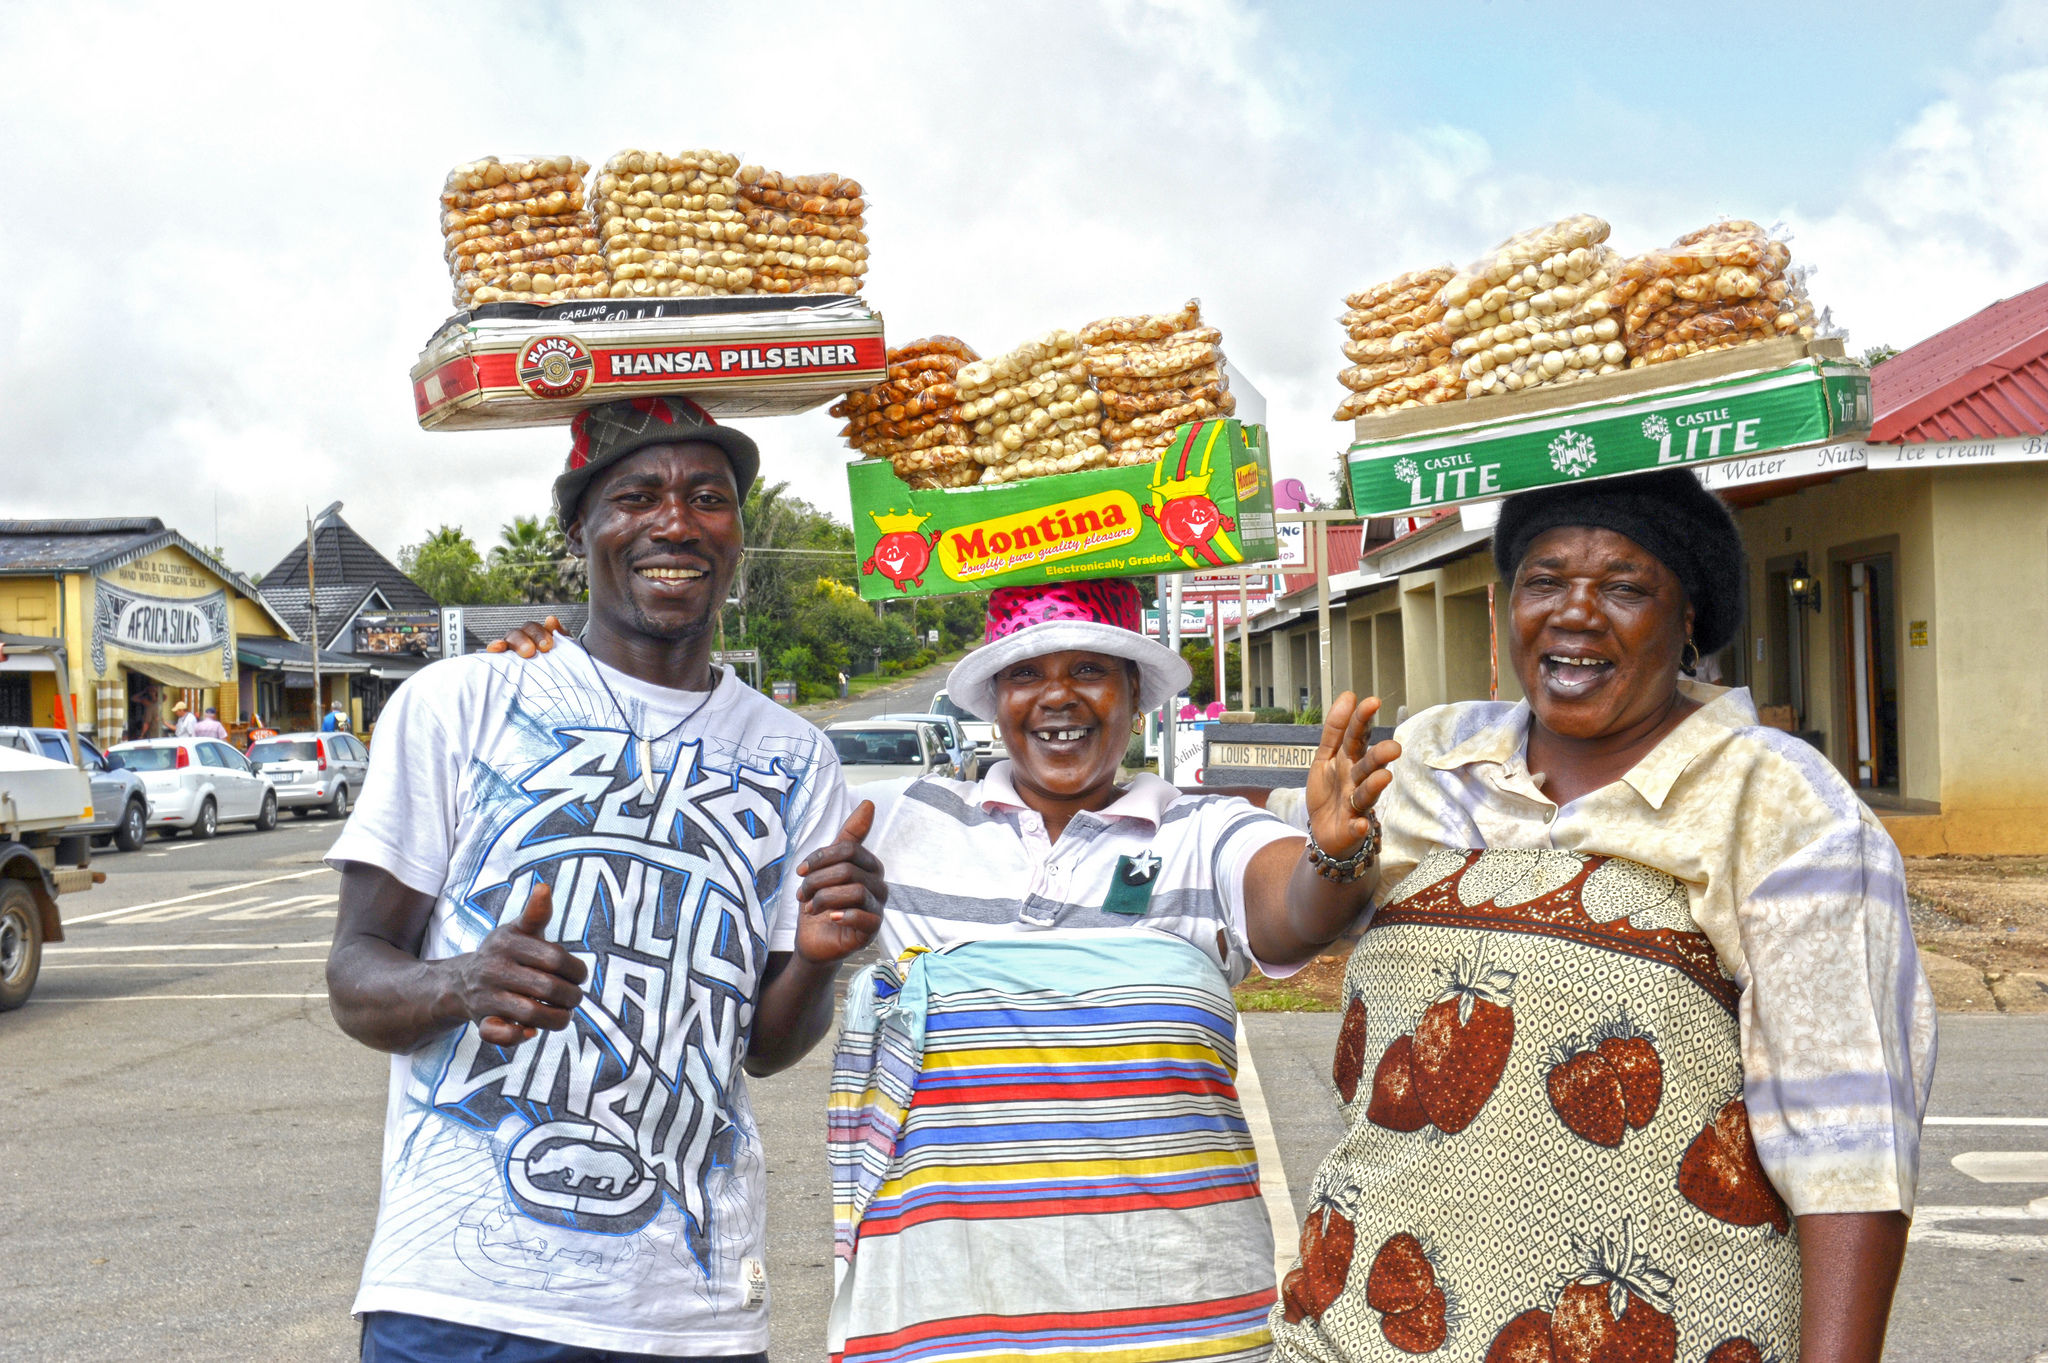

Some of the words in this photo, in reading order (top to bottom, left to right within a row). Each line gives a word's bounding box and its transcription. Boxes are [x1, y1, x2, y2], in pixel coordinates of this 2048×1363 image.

[560, 305, 606, 320] CARLING
[527, 339, 578, 364] HANSA
[610, 352, 714, 375] HANSA
[720, 345, 857, 370] PILSENER
[537, 375, 584, 396] PILSENER
[1676, 408, 1730, 427] CASTLE
[1657, 418, 1761, 465] LITE
[1896, 445, 1926, 462] Ice
[1936, 443, 1996, 459] cream
[1424, 453, 1473, 470] CASTLE
[1722, 458, 1786, 480] Water
[1817, 446, 1865, 467] Nuts
[1410, 463, 1501, 505] LITE
[951, 504, 1126, 563] Montina
[958, 557, 1006, 576] Longlife
[1007, 551, 1035, 565] pure
[1038, 538, 1081, 561] quality
[1083, 527, 1134, 550] pleasure
[158, 563, 194, 576] CULTIVATED
[1046, 558, 1126, 576] Electronically
[1128, 552, 1172, 567] Graded
[120, 569, 137, 580] HAND
[139, 571, 160, 583] WOVEN
[163, 574, 187, 586] AFRICAN
[189, 577, 205, 588] SILKS
[127, 605, 168, 644] AFRICA
[169, 608, 200, 645] SILKS
[1221, 746, 1250, 764] LOUIS
[1256, 747, 1314, 767] TRICHARDT
